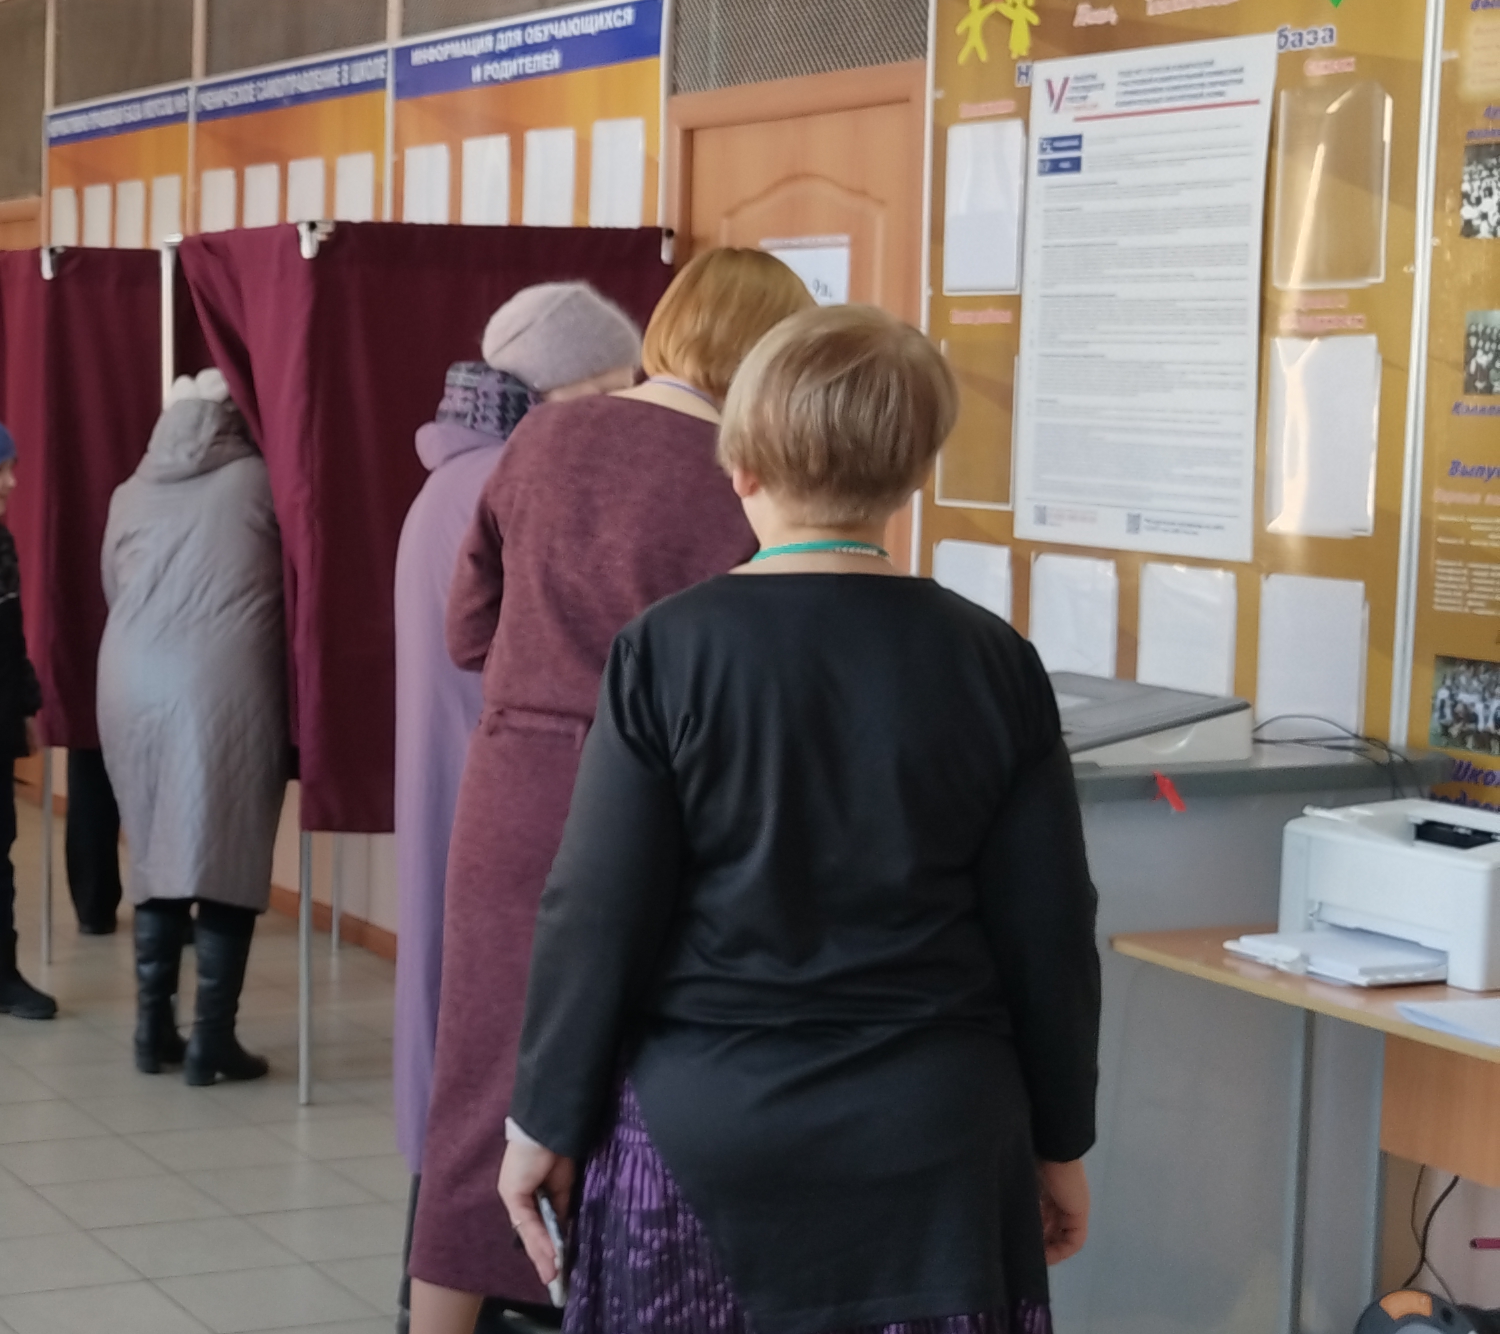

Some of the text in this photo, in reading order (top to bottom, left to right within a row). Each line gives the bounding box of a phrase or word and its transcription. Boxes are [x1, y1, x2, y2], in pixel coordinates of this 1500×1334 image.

[495, 29, 523, 55] ДЛЯ
[524, 6, 635, 47] ОБУЧАЮЩИХСЯ
[1277, 26, 1334, 51] база
[483, 48, 562, 82] РОДИТЕЛЕЙ
